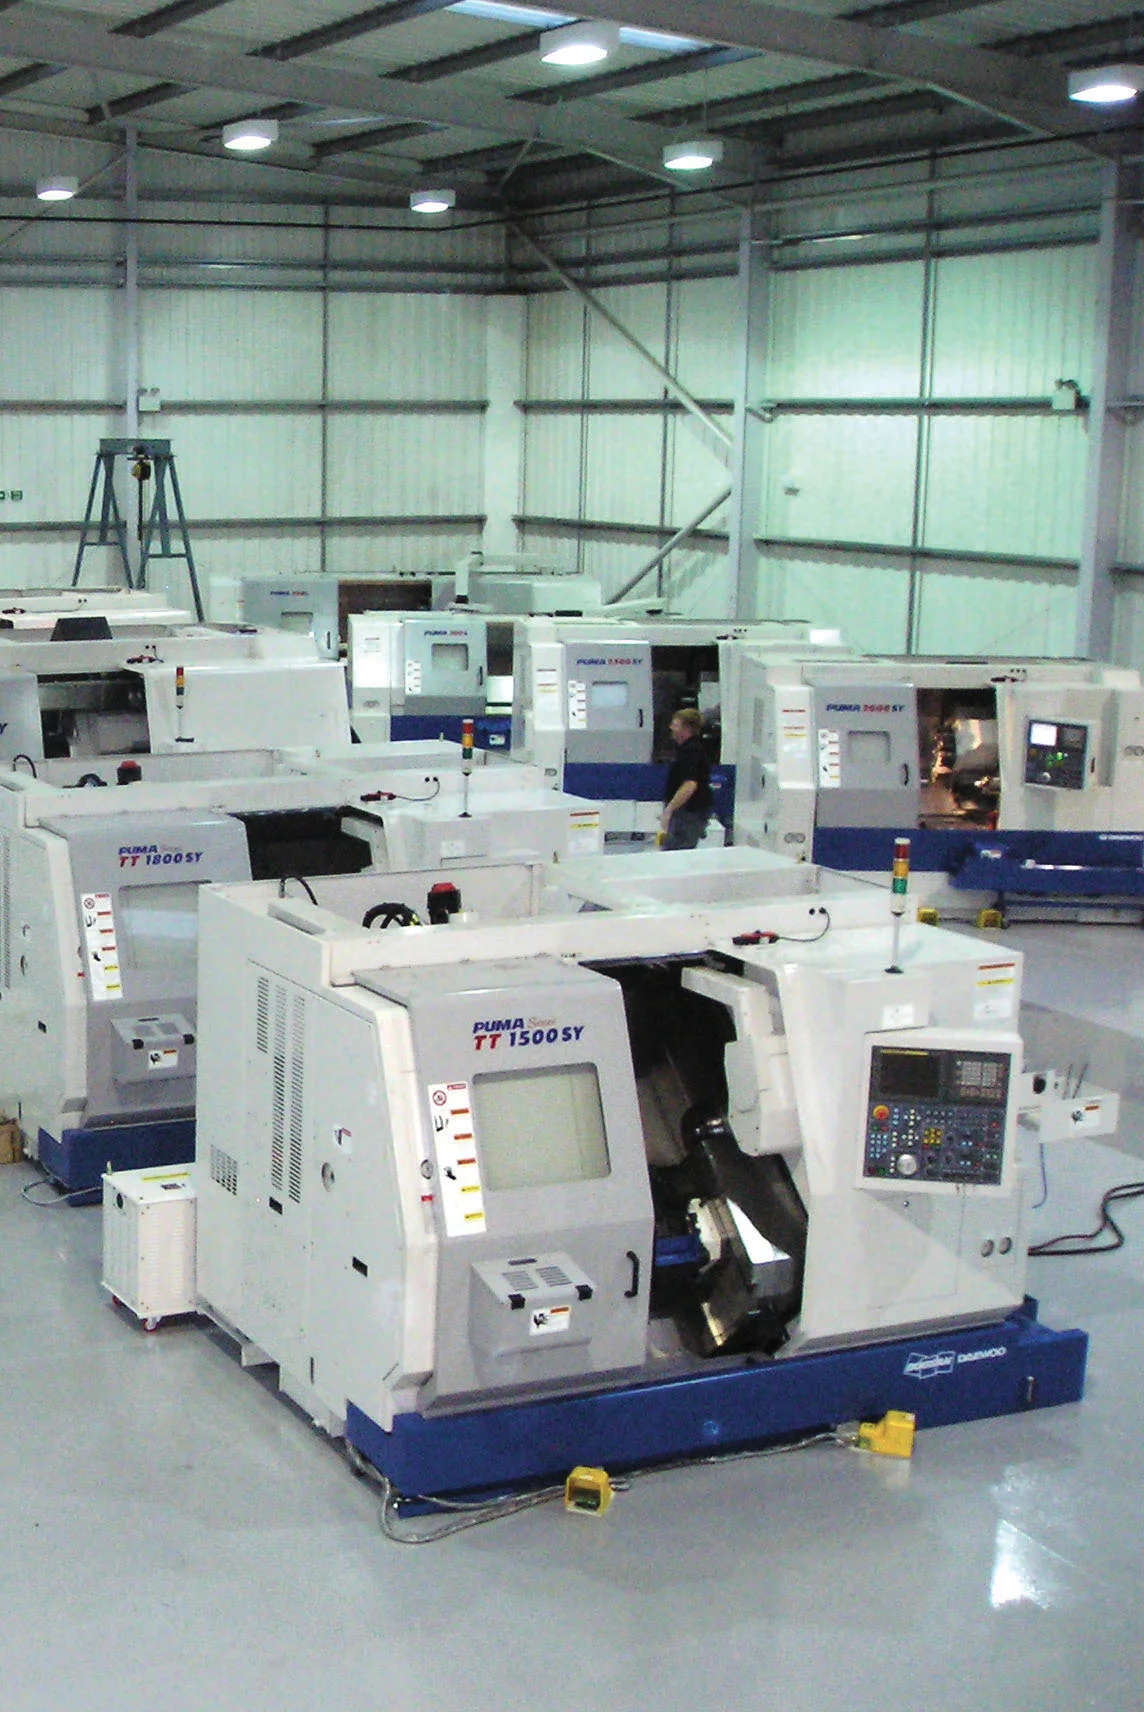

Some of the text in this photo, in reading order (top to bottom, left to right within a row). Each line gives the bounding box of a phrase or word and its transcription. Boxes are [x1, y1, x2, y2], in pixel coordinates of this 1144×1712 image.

[118, 845, 158, 855] PUMA
[119, 856, 140, 867] TT
[472, 1018, 524, 1034] PUMA
[473, 1033, 502, 1051] TT
[957, 1346, 1007, 1364] DAEWOO
